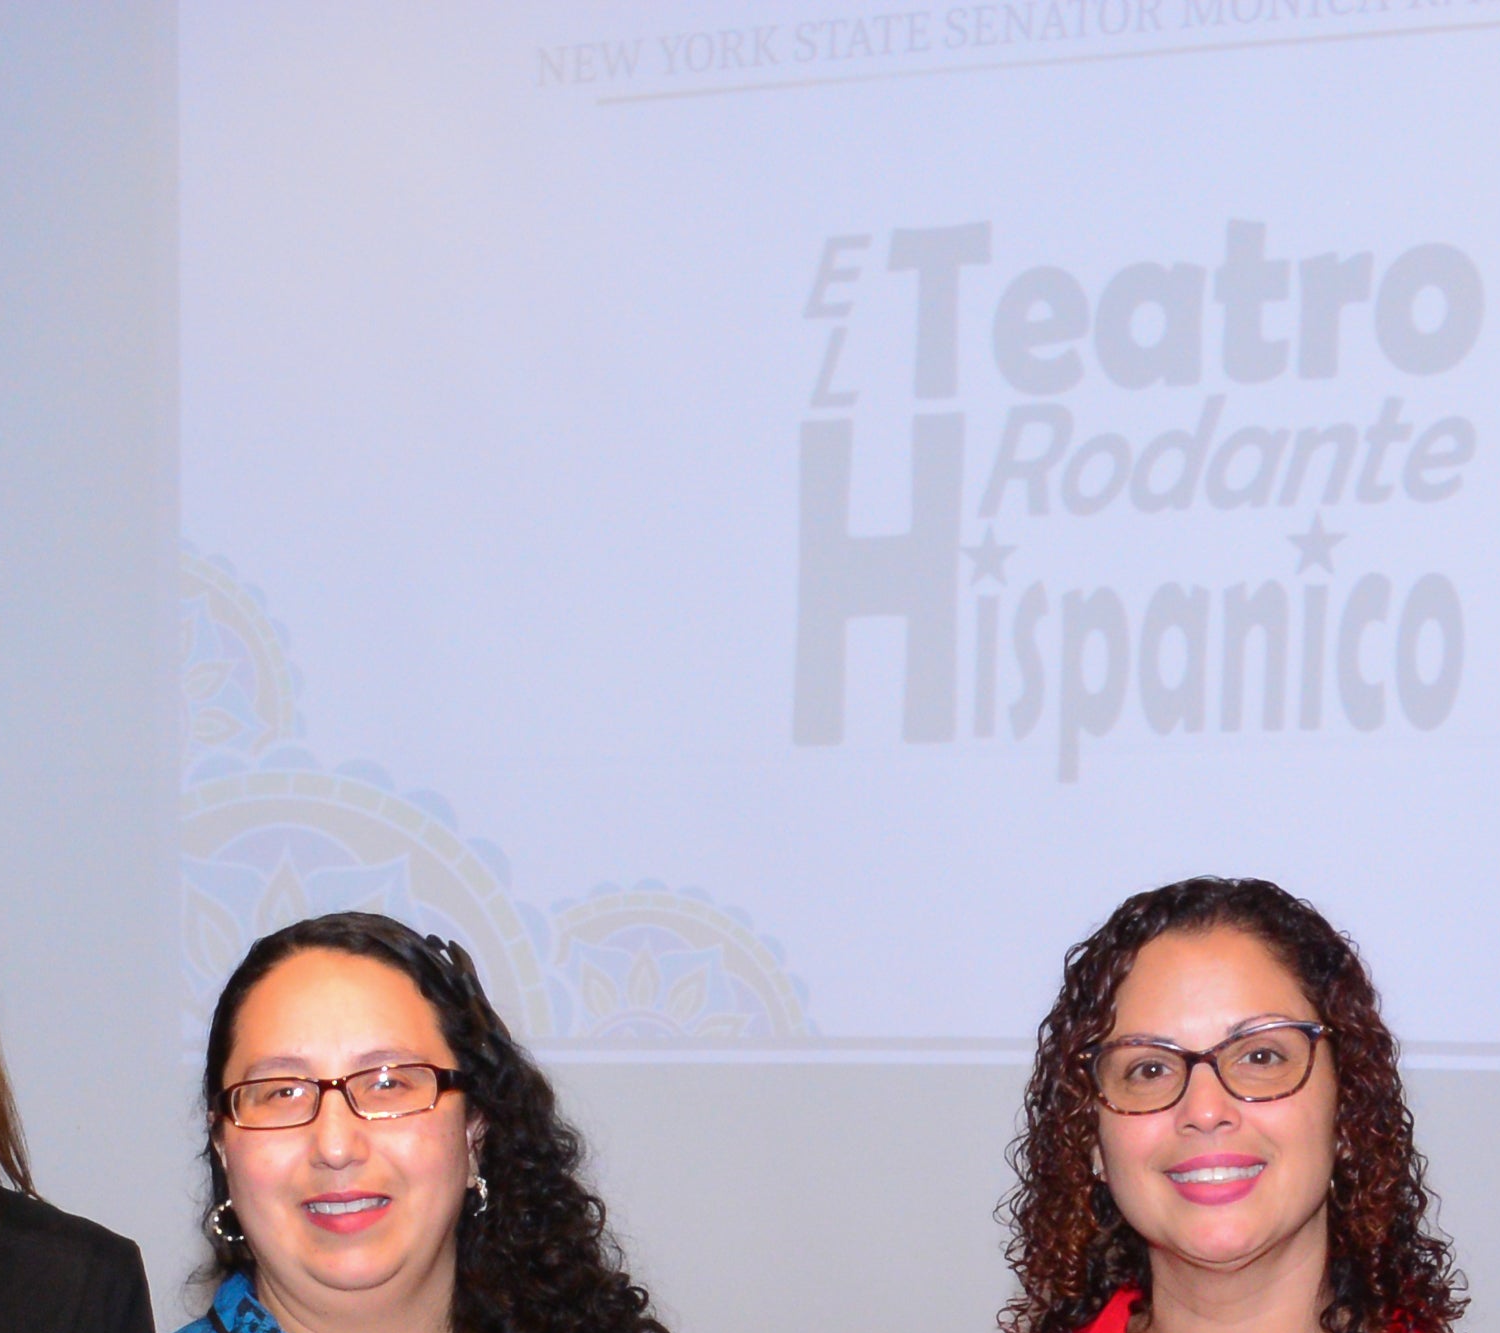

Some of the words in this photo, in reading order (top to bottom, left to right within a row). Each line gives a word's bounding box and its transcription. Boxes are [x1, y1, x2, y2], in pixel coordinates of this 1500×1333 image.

[536, 39, 642, 88] NEW
[657, 24, 780, 75] YORK
[793, 10, 933, 64] STATE
[942, 0, 1163, 50] SENATOR
[886, 217, 1486, 401] Teatro
[975, 393, 1478, 519] Rodante
[792, 411, 1466, 784] Hispanico
